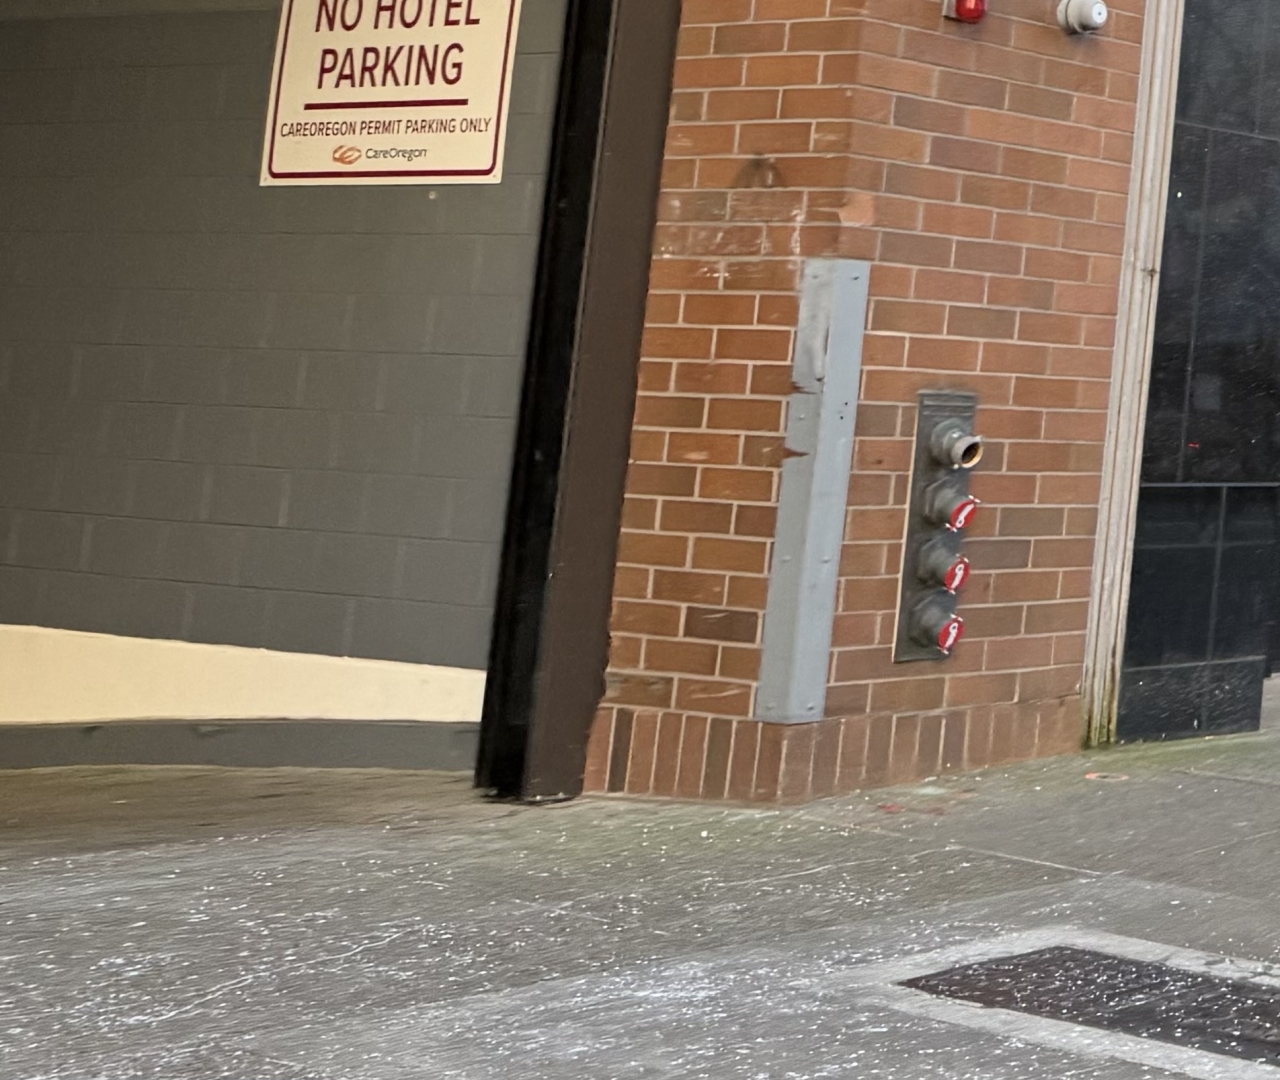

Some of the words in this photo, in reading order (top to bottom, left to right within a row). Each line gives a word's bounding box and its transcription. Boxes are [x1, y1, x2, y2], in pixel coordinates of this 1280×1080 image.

[317, 43, 464, 89] PARKING
[281, 120, 356, 137] CAREOREGON
[359, 119, 403, 136] PERMIT
[405, 117, 456, 135] PARKING
[460, 117, 492, 133] ONLY
